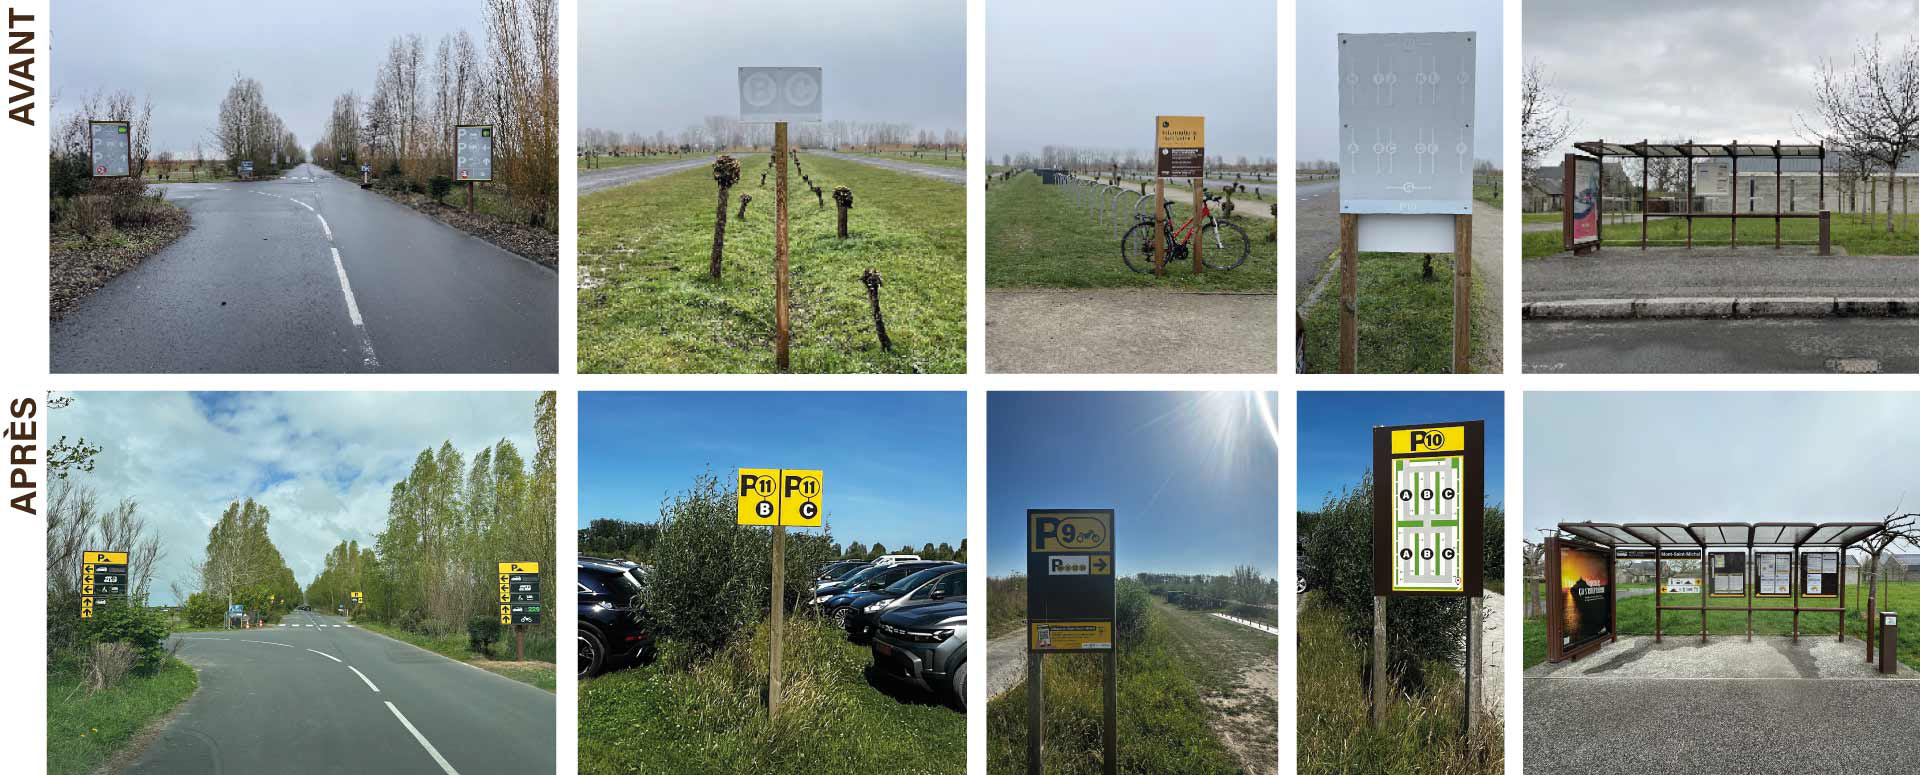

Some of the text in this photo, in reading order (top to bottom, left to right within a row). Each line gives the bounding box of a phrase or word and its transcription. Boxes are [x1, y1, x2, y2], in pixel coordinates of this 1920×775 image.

[1402, 491, 1410, 499] A
[1444, 489, 1453, 498] C
[760, 503, 770, 515] B
[803, 504, 814, 516] C
[98, 554, 105, 562] P
[1402, 550, 1410, 558] A
[1444, 549, 1453, 558] C
